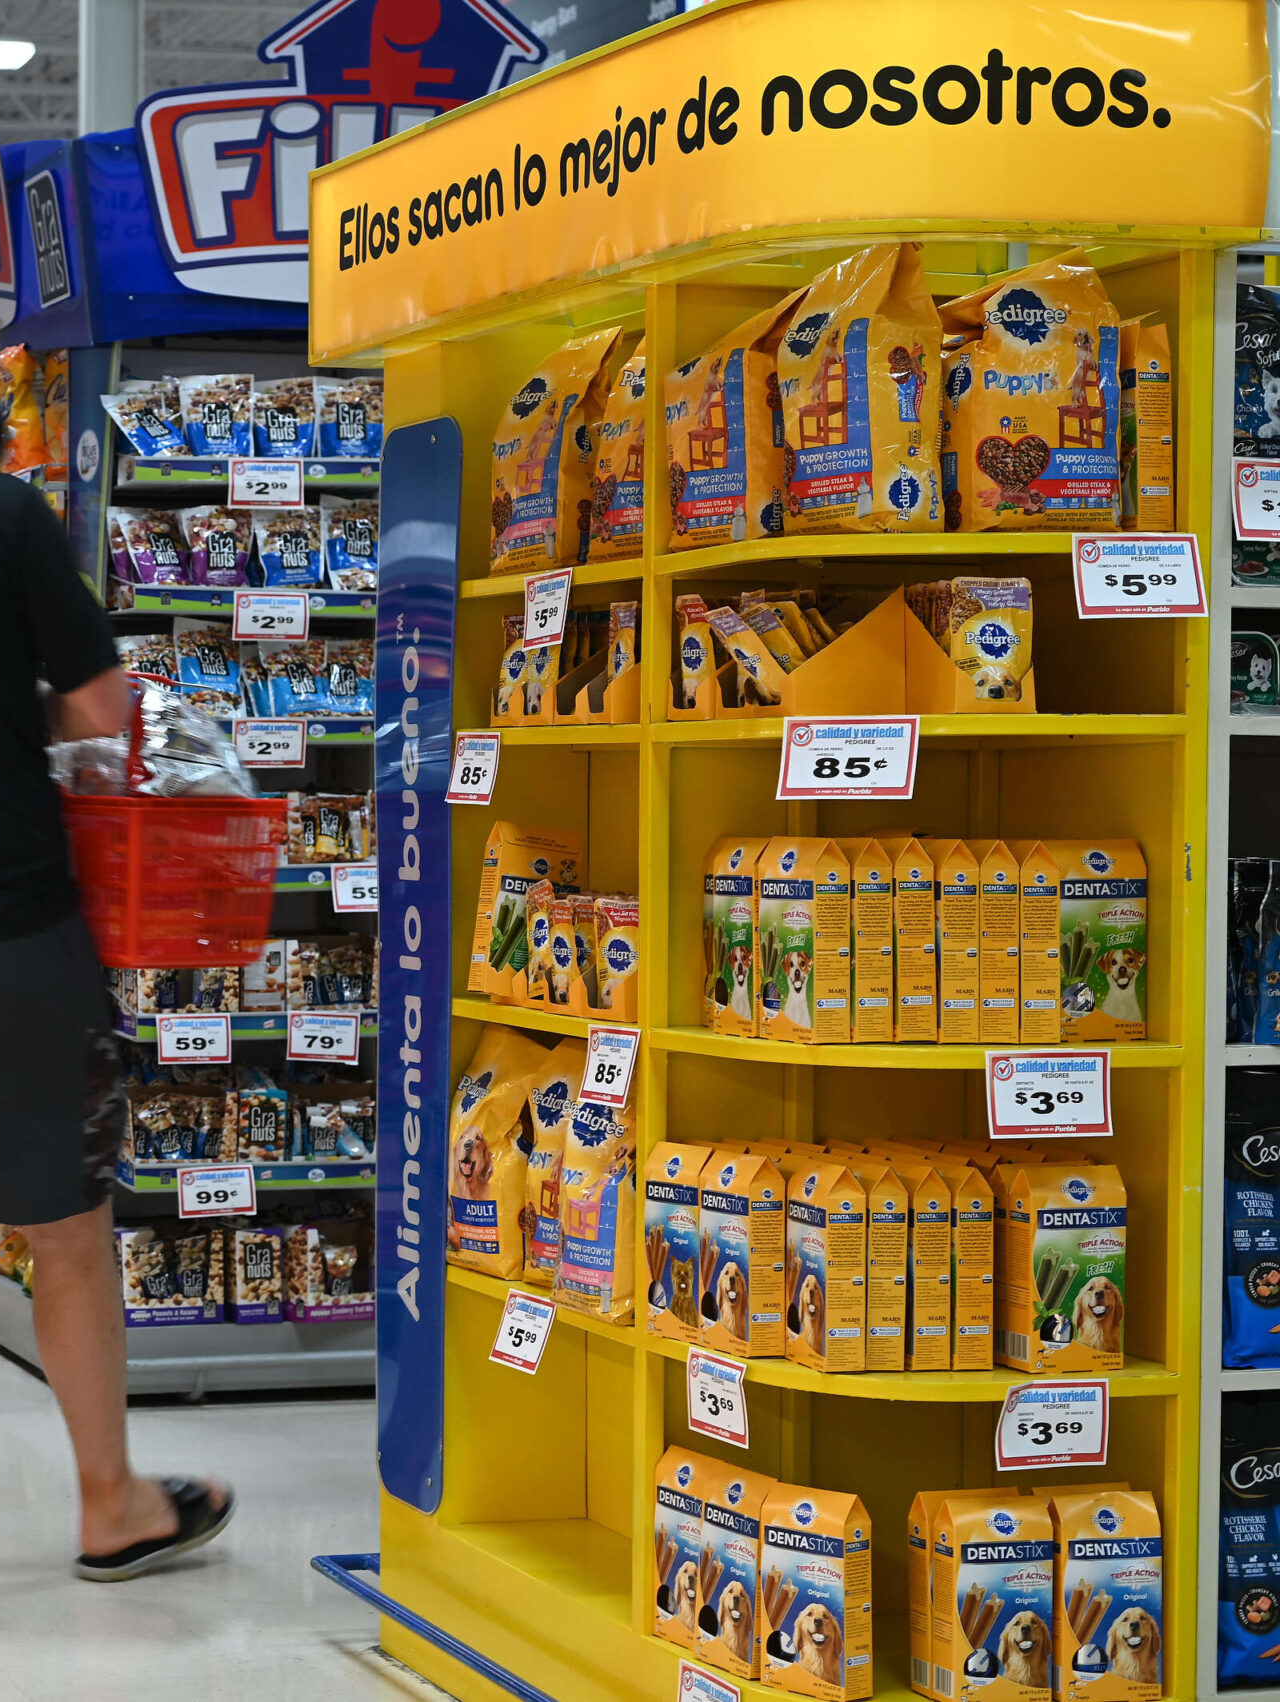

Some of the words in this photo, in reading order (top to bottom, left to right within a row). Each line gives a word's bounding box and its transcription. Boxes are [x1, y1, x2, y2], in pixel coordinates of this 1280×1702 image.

[339, 203, 400, 272] Ellos
[407, 166, 504, 247] sacan
[513, 144, 547, 211] lo
[560, 105, 667, 197] mejor
[675, 75, 740, 154] de
[761, 48, 1172, 136] nosotros.
[984, 370, 1043, 396] Puppy
[205, 403, 231, 425] Gra
[339, 403, 365, 424] Gra
[339, 421, 365, 440] nuts
[825, 447, 868, 460] GROWTH
[1087, 454, 1118, 464] GROWTH
[813, 458, 869, 473] PROTECTION
[1072, 464, 1118, 475] PROTECTION
[710, 472, 744, 484] GROWTH
[810, 478, 830, 488] GRILLED
[831, 476, 848, 485] STEAK
[1067, 481, 1088, 489] GRILLED
[701, 482, 743, 494] PROTECTION
[807, 485, 832, 496] VEGETABLE
[833, 483, 855, 492] FLAVOR
[897, 464, 911, 522] Pedigree
[1060, 488, 1089, 496] VEGETABLE
[345, 521, 370, 541] Gra
[151, 533, 175, 552] Gra
[209, 533, 234, 554] Gra
[282, 533, 308, 553] Gra
[1102, 544, 1136, 556] calidad
[1144, 543, 1185, 556] variedad
[209, 551, 236, 569] nuts
[964, 632, 1022, 647] Pedigree
[197, 645, 224, 665] Gra
[288, 663, 312, 682] Gra
[815, 727, 852, 739] calidad
[860, 726, 904, 738] variedad
[398, 626, 421, 882] bueno.
[813, 757, 889, 779] 85¢
[460, 766, 487, 786] 85¢
[321, 807, 340, 826] Gra
[715, 878, 750, 893] DENTASTIX
[762, 882, 808, 897] DENTASTIX
[1064, 882, 1138, 897] DENTASTIX
[1097, 910, 1118, 920] TRIPLE
[1119, 909, 1145, 919] ACTION
[399, 905, 422, 970] lo
[1107, 931, 1134, 947] FRESH
[175, 1037, 216, 1051] 59¢
[303, 1034, 344, 1050] 79¢
[594, 1063, 623, 1084] 85¢
[1015, 1060, 1049, 1073] calidad
[1057, 1059, 1097, 1072] variedad
[250, 1106, 276, 1128] Gra
[250, 1125, 276, 1142] nuts
[397, 994, 422, 1322] Alimenta
[196, 1189, 238, 1204] 99¢
[647, 1184, 694, 1202] DENTASTIX
[465, 1202, 494, 1216] ADULT
[702, 1193, 745, 1213] DENTASTIX
[1243, 1200, 1274, 1209] CHICKEN
[789, 1203, 823, 1224] DENTASTIX
[1043, 1211, 1120, 1226] DENTASTIX
[1247, 1208, 1274, 1218] FLAVOR
[581, 1243, 612, 1257] GROWTH
[1078, 1239, 1098, 1250] TRIPLE
[1099, 1238, 1125, 1249] ACTION
[246, 1243, 271, 1265] Gra
[574, 1252, 612, 1267] PROTECTION
[247, 1262, 272, 1279] nuts
[1086, 1260, 1113, 1276] FRESH
[183, 1269, 204, 1288] Gra
[1056, 1389, 1097, 1402] variedad
[706, 1506, 753, 1534] DENTASTIX
[1223, 1515, 1268, 1526] ROTISSERIE
[1229, 1524, 1266, 1535] CHICKEN
[768, 1529, 835, 1554] DENTASTIX
[1234, 1533, 1266, 1543] FLAVOR
[967, 1544, 1045, 1560] DENTASTIX
[1074, 1541, 1152, 1557] DENTASTIX
[795, 1564, 816, 1574] TRIPLE
[817, 1566, 843, 1580] ACTION
[1002, 1574, 1025, 1583] TRIPLE
[1026, 1572, 1052, 1582] ACTION
[1111, 1571, 1133, 1580] TRIPLE
[1133, 1569, 1161, 1578] ACTION
[807, 1588, 831, 1599] Original
[1015, 1596, 1039, 1605] Original
[1123, 1592, 1148, 1601] Original
